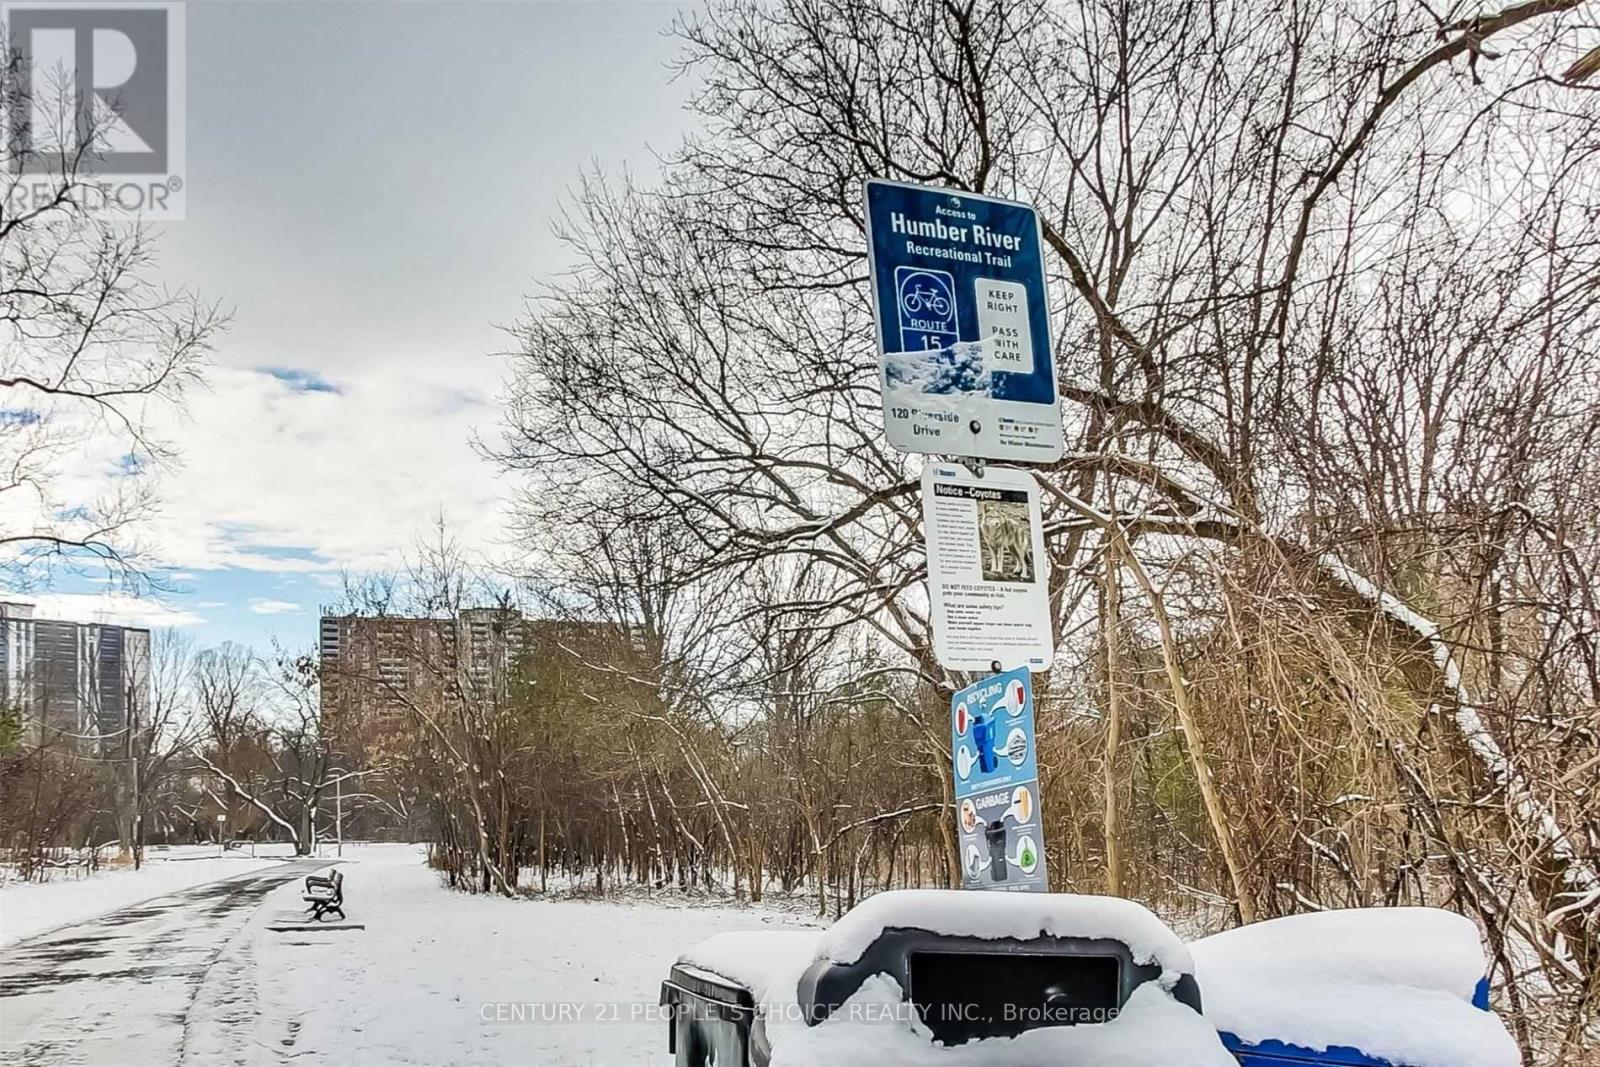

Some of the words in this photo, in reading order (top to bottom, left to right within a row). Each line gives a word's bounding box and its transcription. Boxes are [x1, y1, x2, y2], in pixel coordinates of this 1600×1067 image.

[936, 205, 966, 219] Access
[968, 212, 976, 221] to
[891, 212, 968, 243] Humber
[973, 224, 1021, 251] River
[906, 241, 982, 264] Recreational
[984, 252, 1012, 268] Trail
[988, 290, 1014, 300] KEEP
[987, 302, 1018, 313] RIGHT
[911, 318, 948, 331] ROUTE
[992, 326, 1018, 337] PASS
[921, 335, 942, 351] 15
[994, 350, 1021, 362] CARE
[892, 408, 909, 419] 120
[912, 409, 960, 423] Rerside
[914, 424, 941, 436] Drive
[936, 485, 963, 496] Notice
[967, 682, 1002, 704] RECYCLING
[976, 792, 1010, 810] GARBAGE
